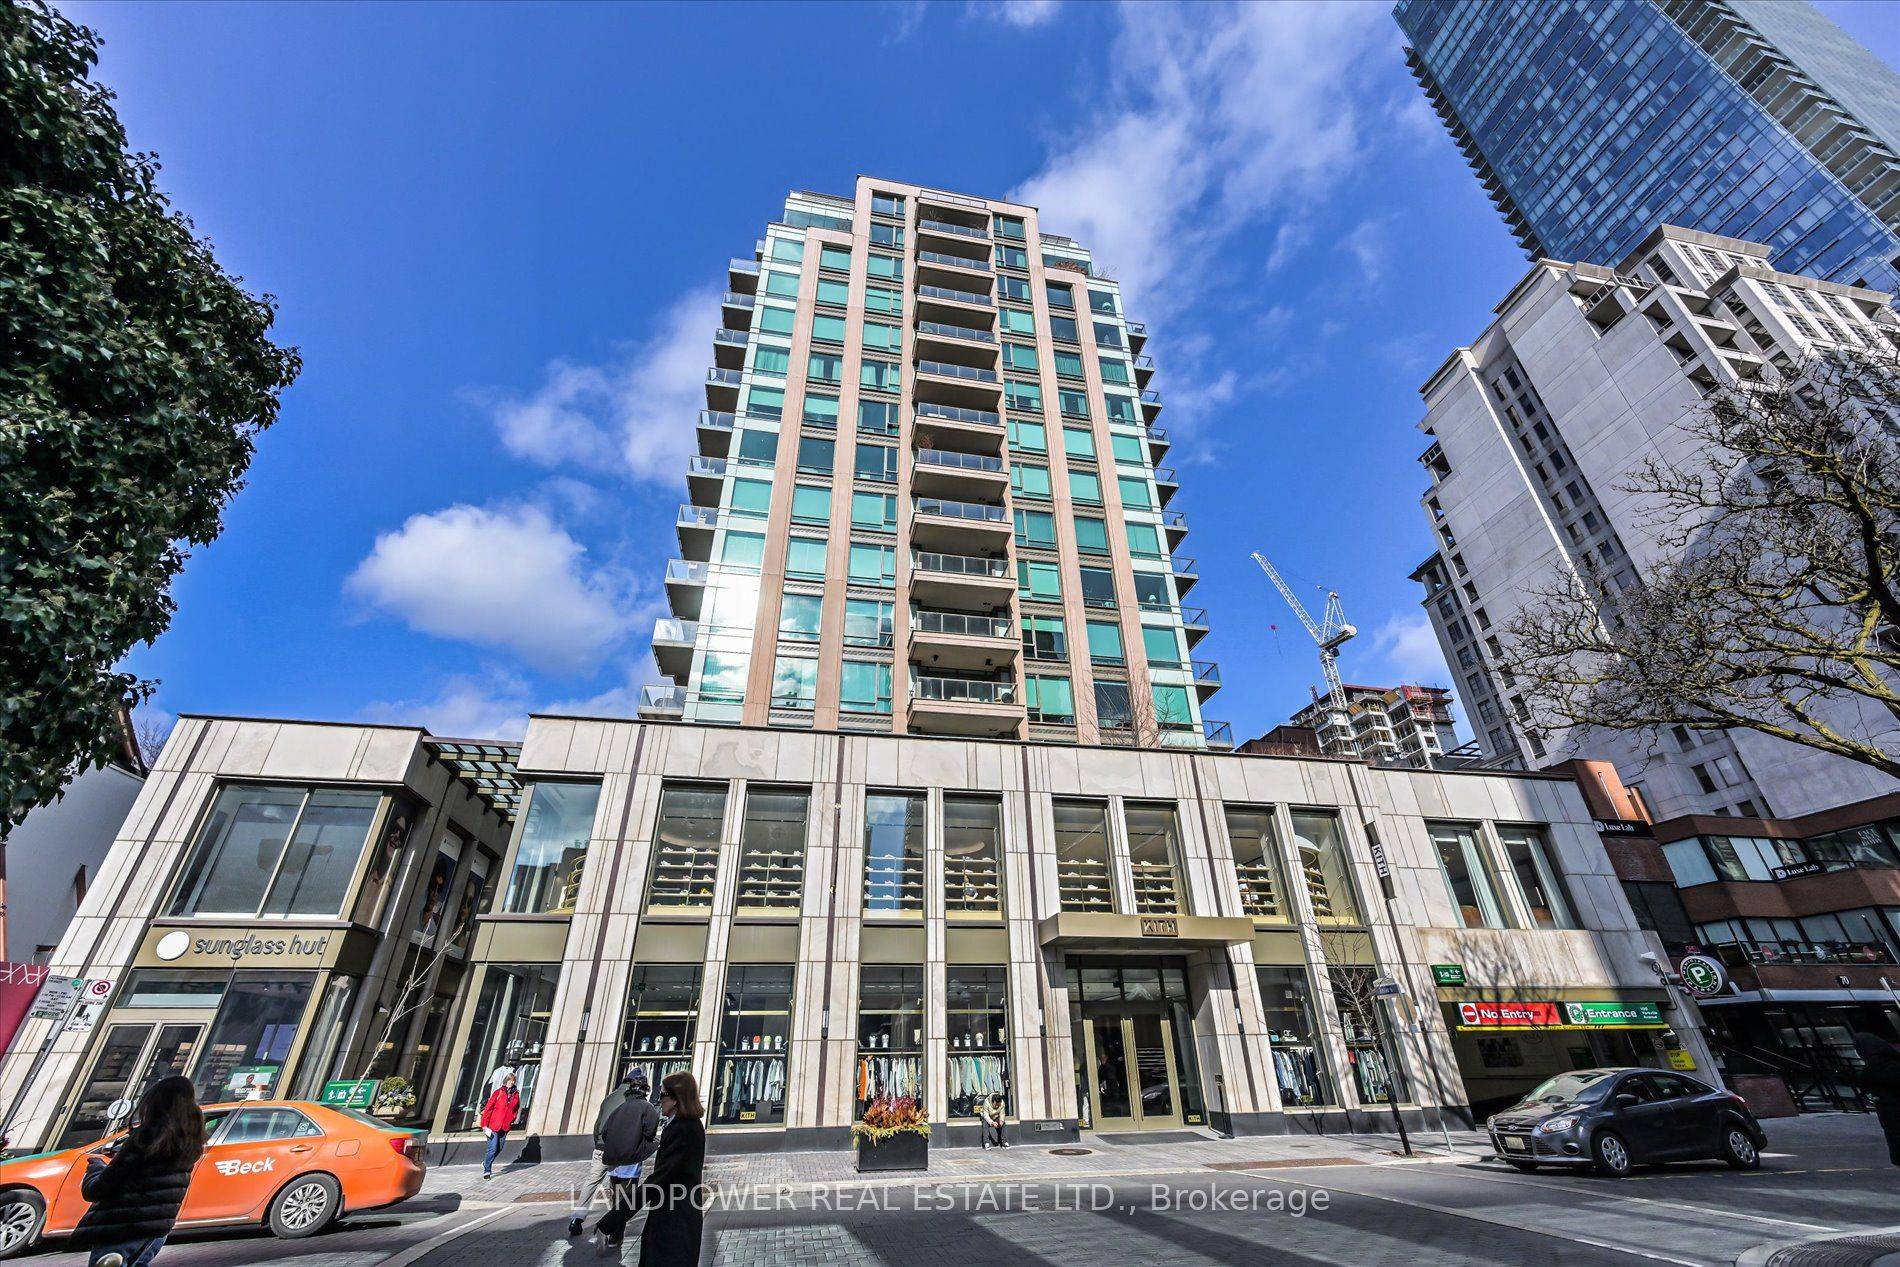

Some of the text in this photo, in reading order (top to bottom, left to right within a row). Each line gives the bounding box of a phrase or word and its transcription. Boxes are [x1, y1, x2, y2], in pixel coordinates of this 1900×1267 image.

[1620, 823, 1635, 832] Lab
[1373, 846, 1389, 875] KITH
[1786, 864, 1820, 876] Luxe Lab
[1143, 919, 1177, 933] KITH
[193, 934, 327, 960] sunglass hut
[1690, 966, 1706, 982] P
[1840, 975, 1850, 985] 70
[1480, 1009, 1534, 1021] No Entry
[1586, 1009, 1637, 1018] Entrance
[740, 1112, 756, 1120] KITH
[221, 1157, 275, 1176] Beck
